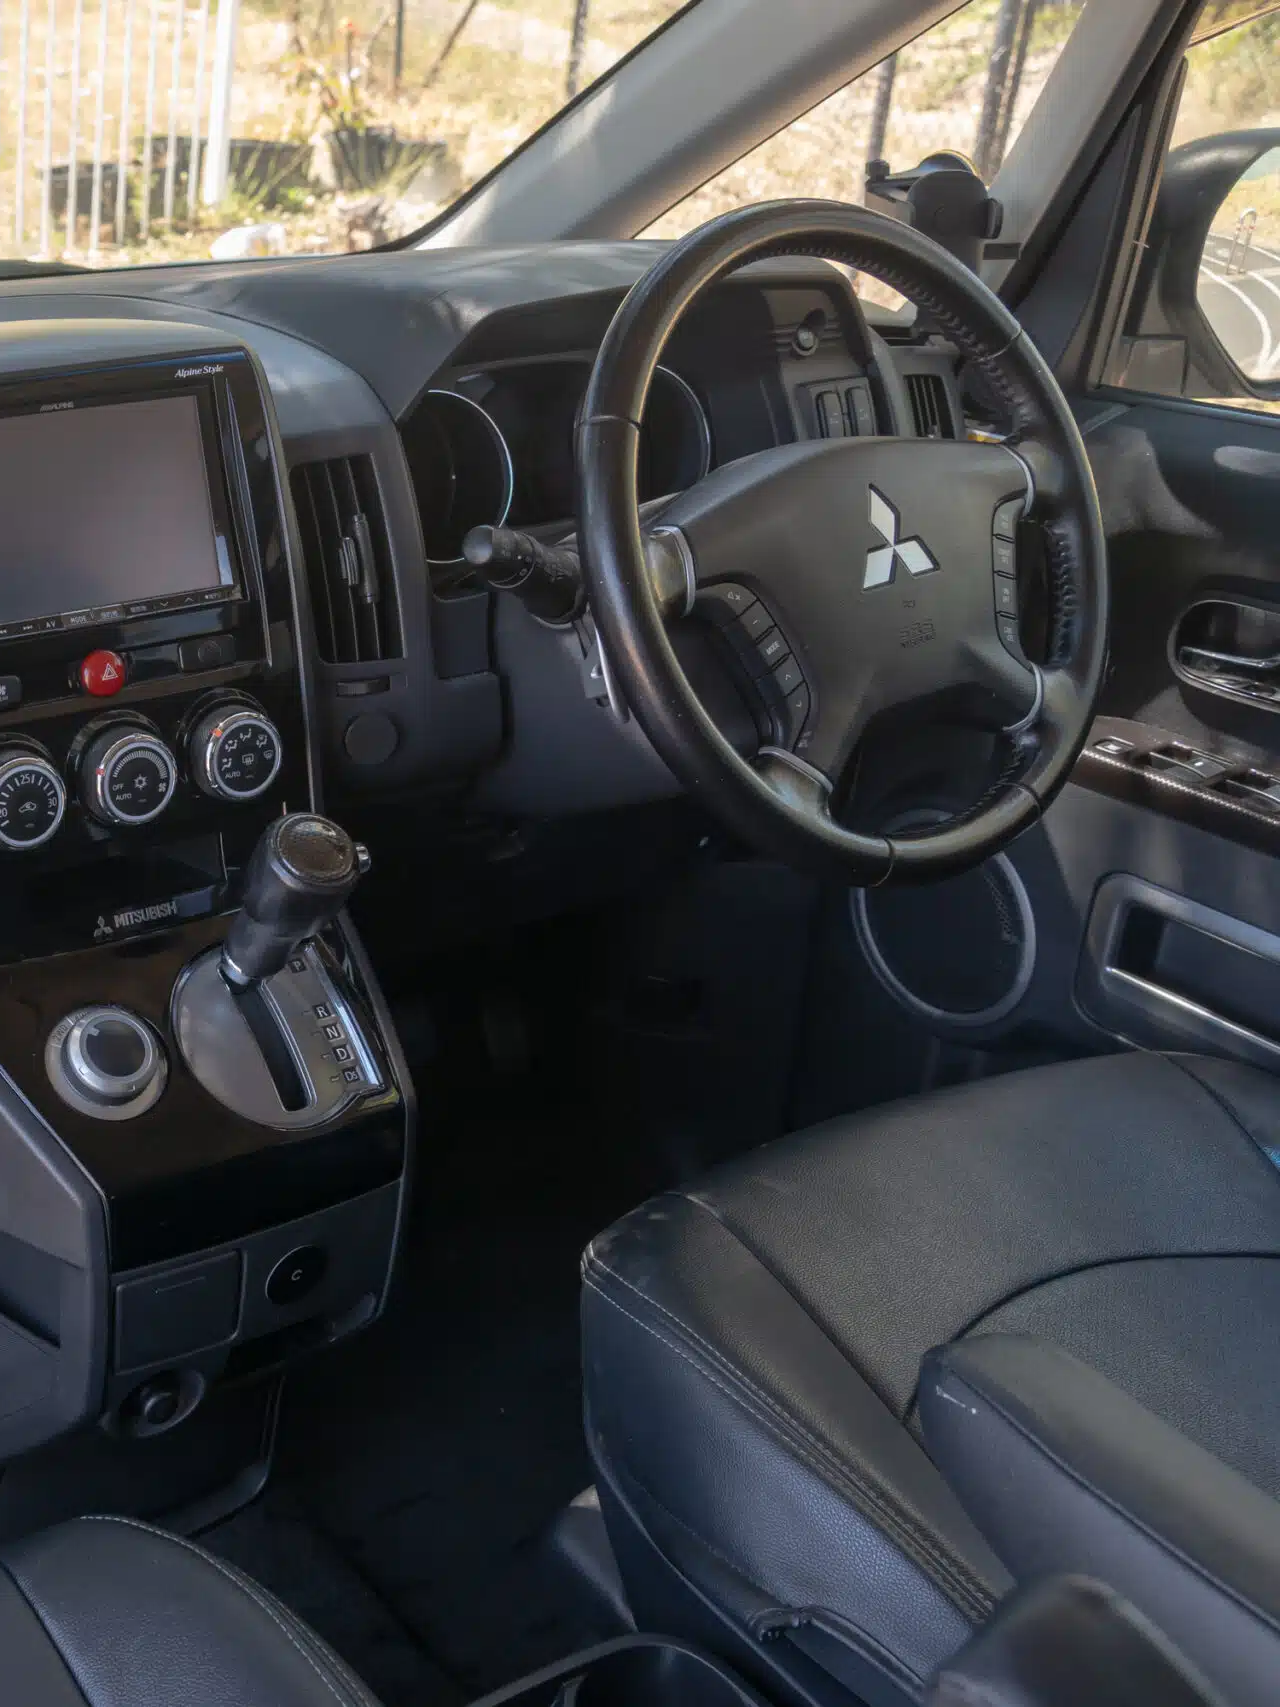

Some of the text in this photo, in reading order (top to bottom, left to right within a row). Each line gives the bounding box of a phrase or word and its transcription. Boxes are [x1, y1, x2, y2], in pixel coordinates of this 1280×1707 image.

[174, 364, 224, 378] Alpine Style
[224, 771, 241, 779] AUTO
[112, 783, 124, 792] OFF
[47, 797, 58, 808] 30
[115, 793, 133, 801] AUTO
[316, 1005, 328, 1017] R
[325, 1026, 338, 1039] N
[335, 1047, 347, 1060] D
